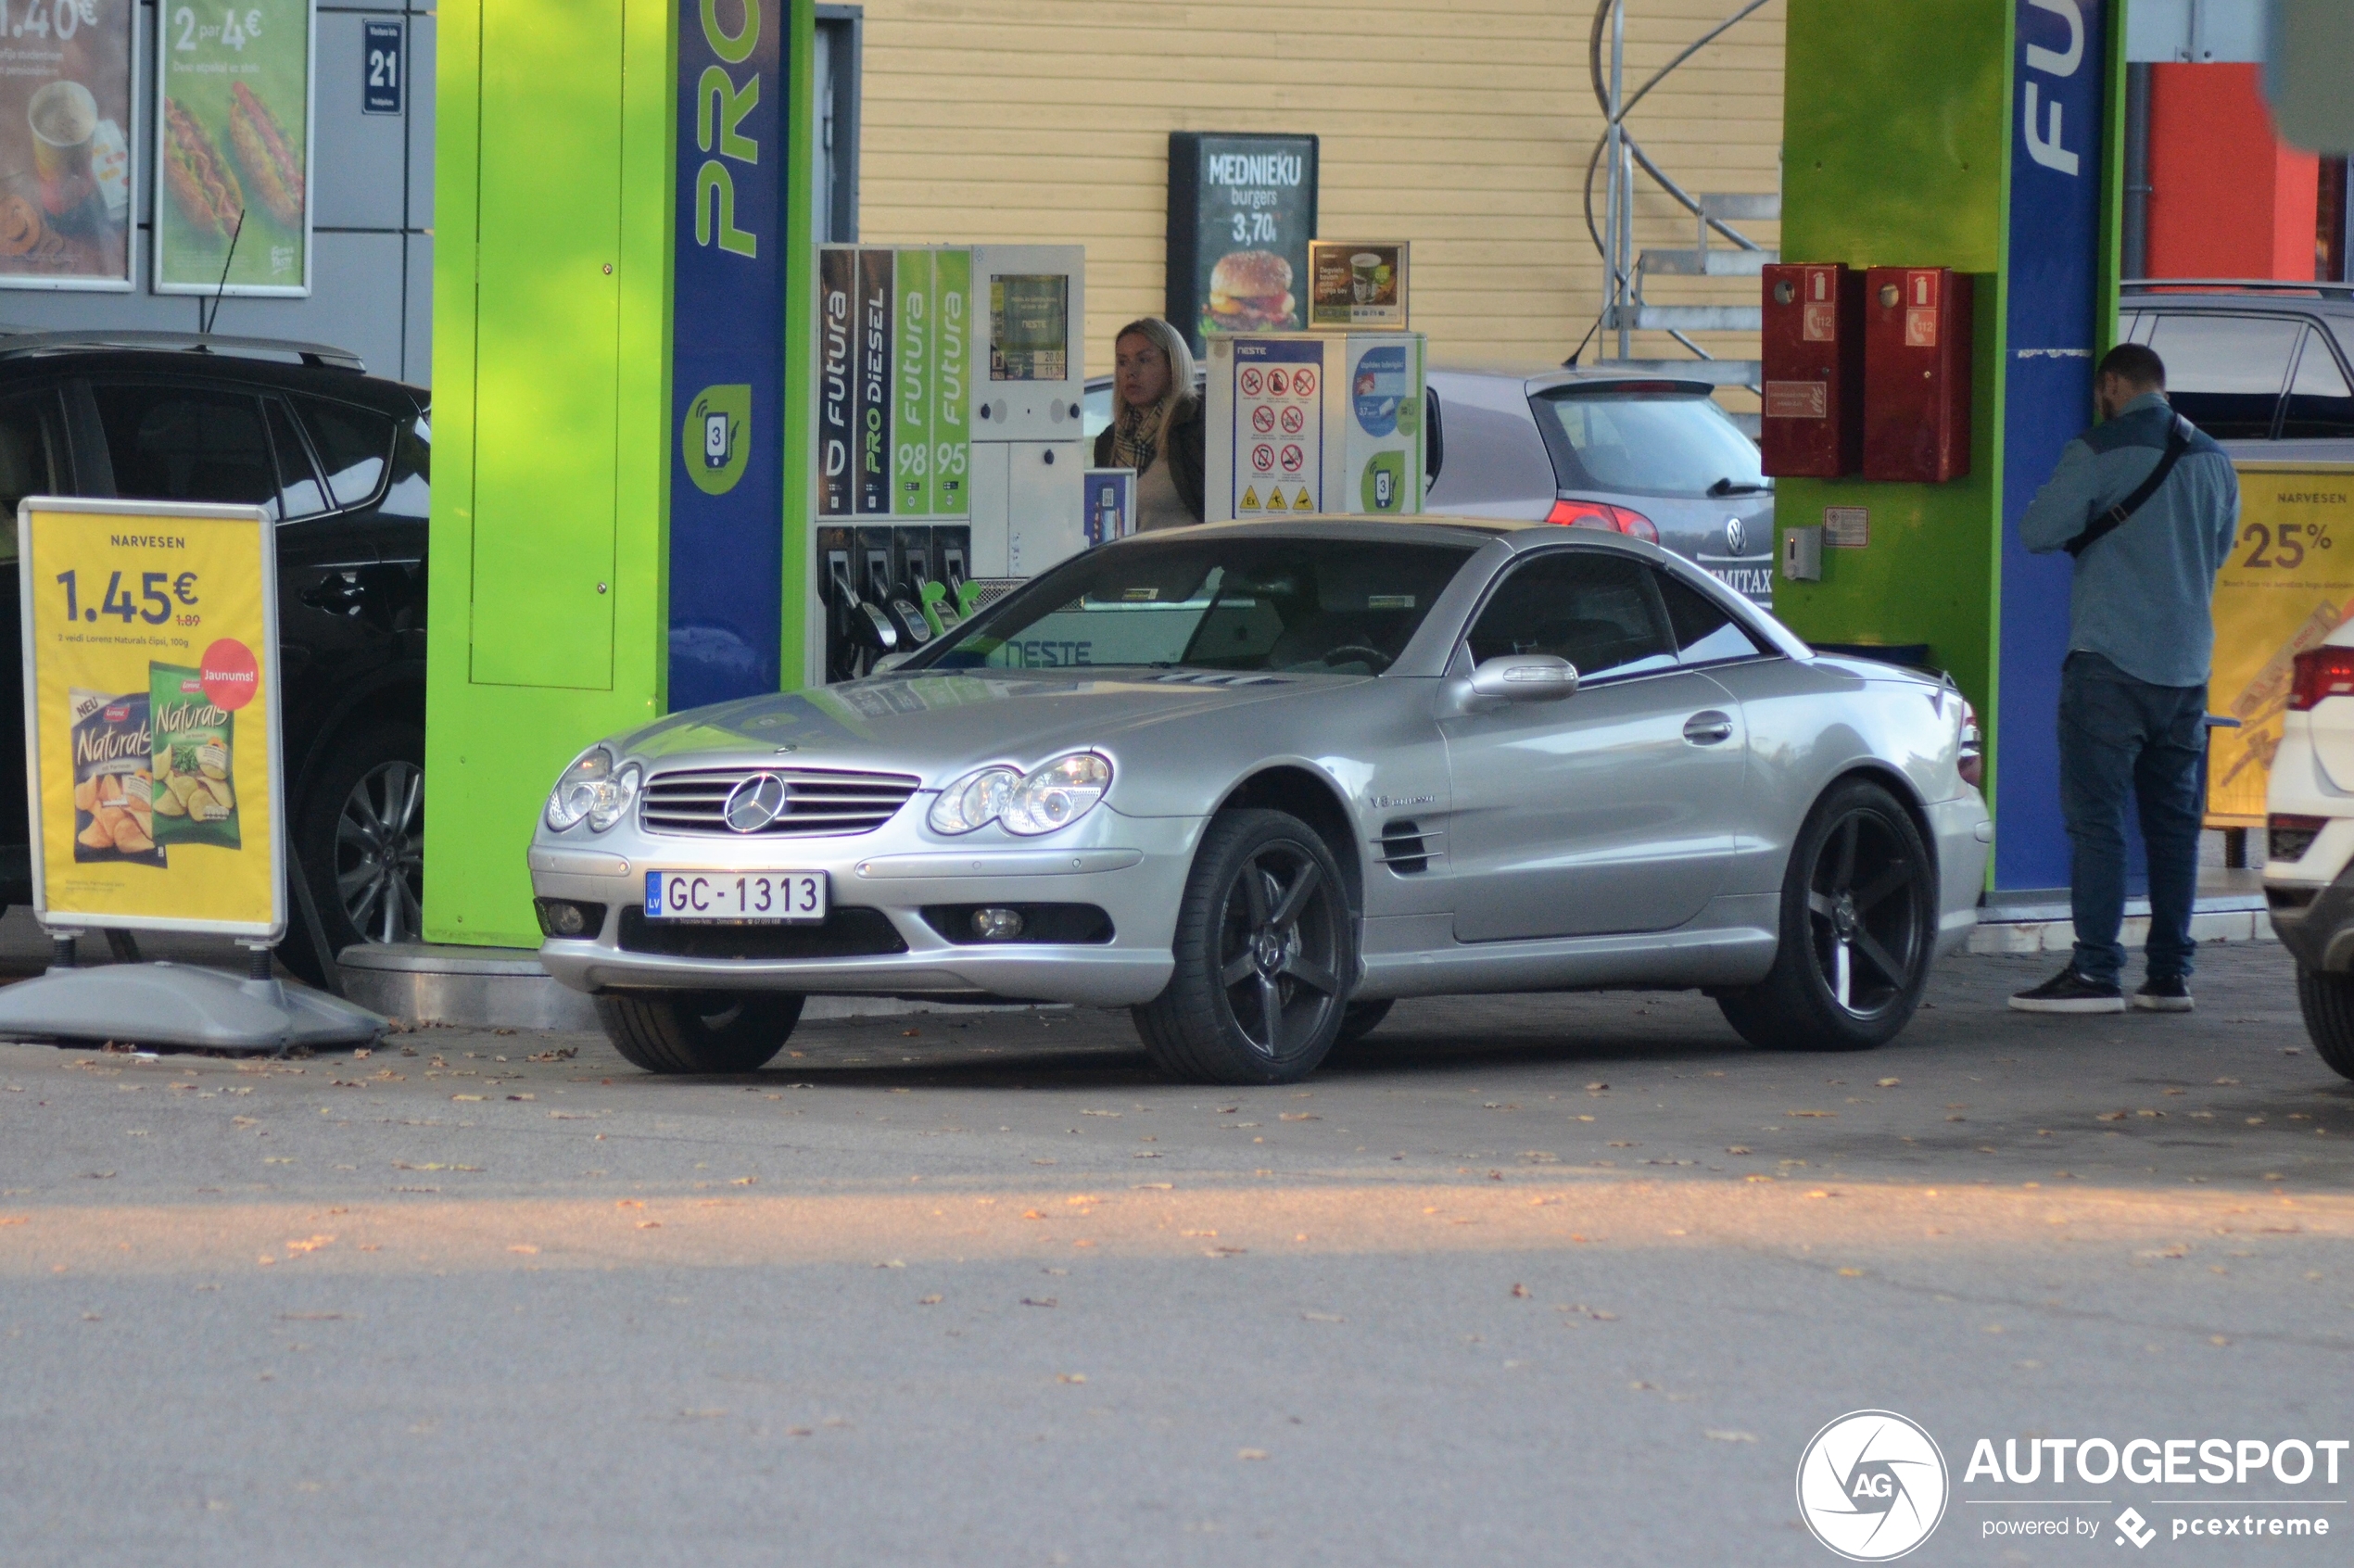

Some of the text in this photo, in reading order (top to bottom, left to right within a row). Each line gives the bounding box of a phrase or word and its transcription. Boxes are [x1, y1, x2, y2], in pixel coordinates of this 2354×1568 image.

[174, 6, 262, 52] 2 par 4€
[370, 49, 397, 88] 21
[1209, 153, 1302, 186] MEDNIEKU
[1231, 186, 1278, 210] burgers
[1816, 316, 1832, 327] 112
[1917, 321, 1934, 333] 112
[1237, 347, 1267, 355] NESTE
[712, 425, 722, 447] 3
[866, 408, 881, 474] PRO
[898, 442, 928, 476] 98
[937, 442, 968, 475] 95
[1379, 479, 1386, 494] 3
[2277, 493, 2347, 503] NARVESEN
[1247, 496, 1256, 506] Ex
[110, 535, 186, 549] NARVESEN
[1712, 568, 1773, 593] MITAX
[56, 569, 199, 626] 1.45€
[175, 614, 201, 626] 1.89
[65, 634, 84, 642] veidi
[86, 634, 112, 644] Lorenz
[114, 636, 146, 645] Naturals
[148, 637, 168, 647] čipsi,
[171, 638, 189, 648] 100g
[1006, 640, 1092, 669] NESTE
[204, 669, 254, 682] Jaunums!
[76, 697, 99, 718] NEU
[156, 700, 229, 736] Naturals
[78, 719, 152, 765] Naturals
[649, 877, 817, 912] LV GC-1313
